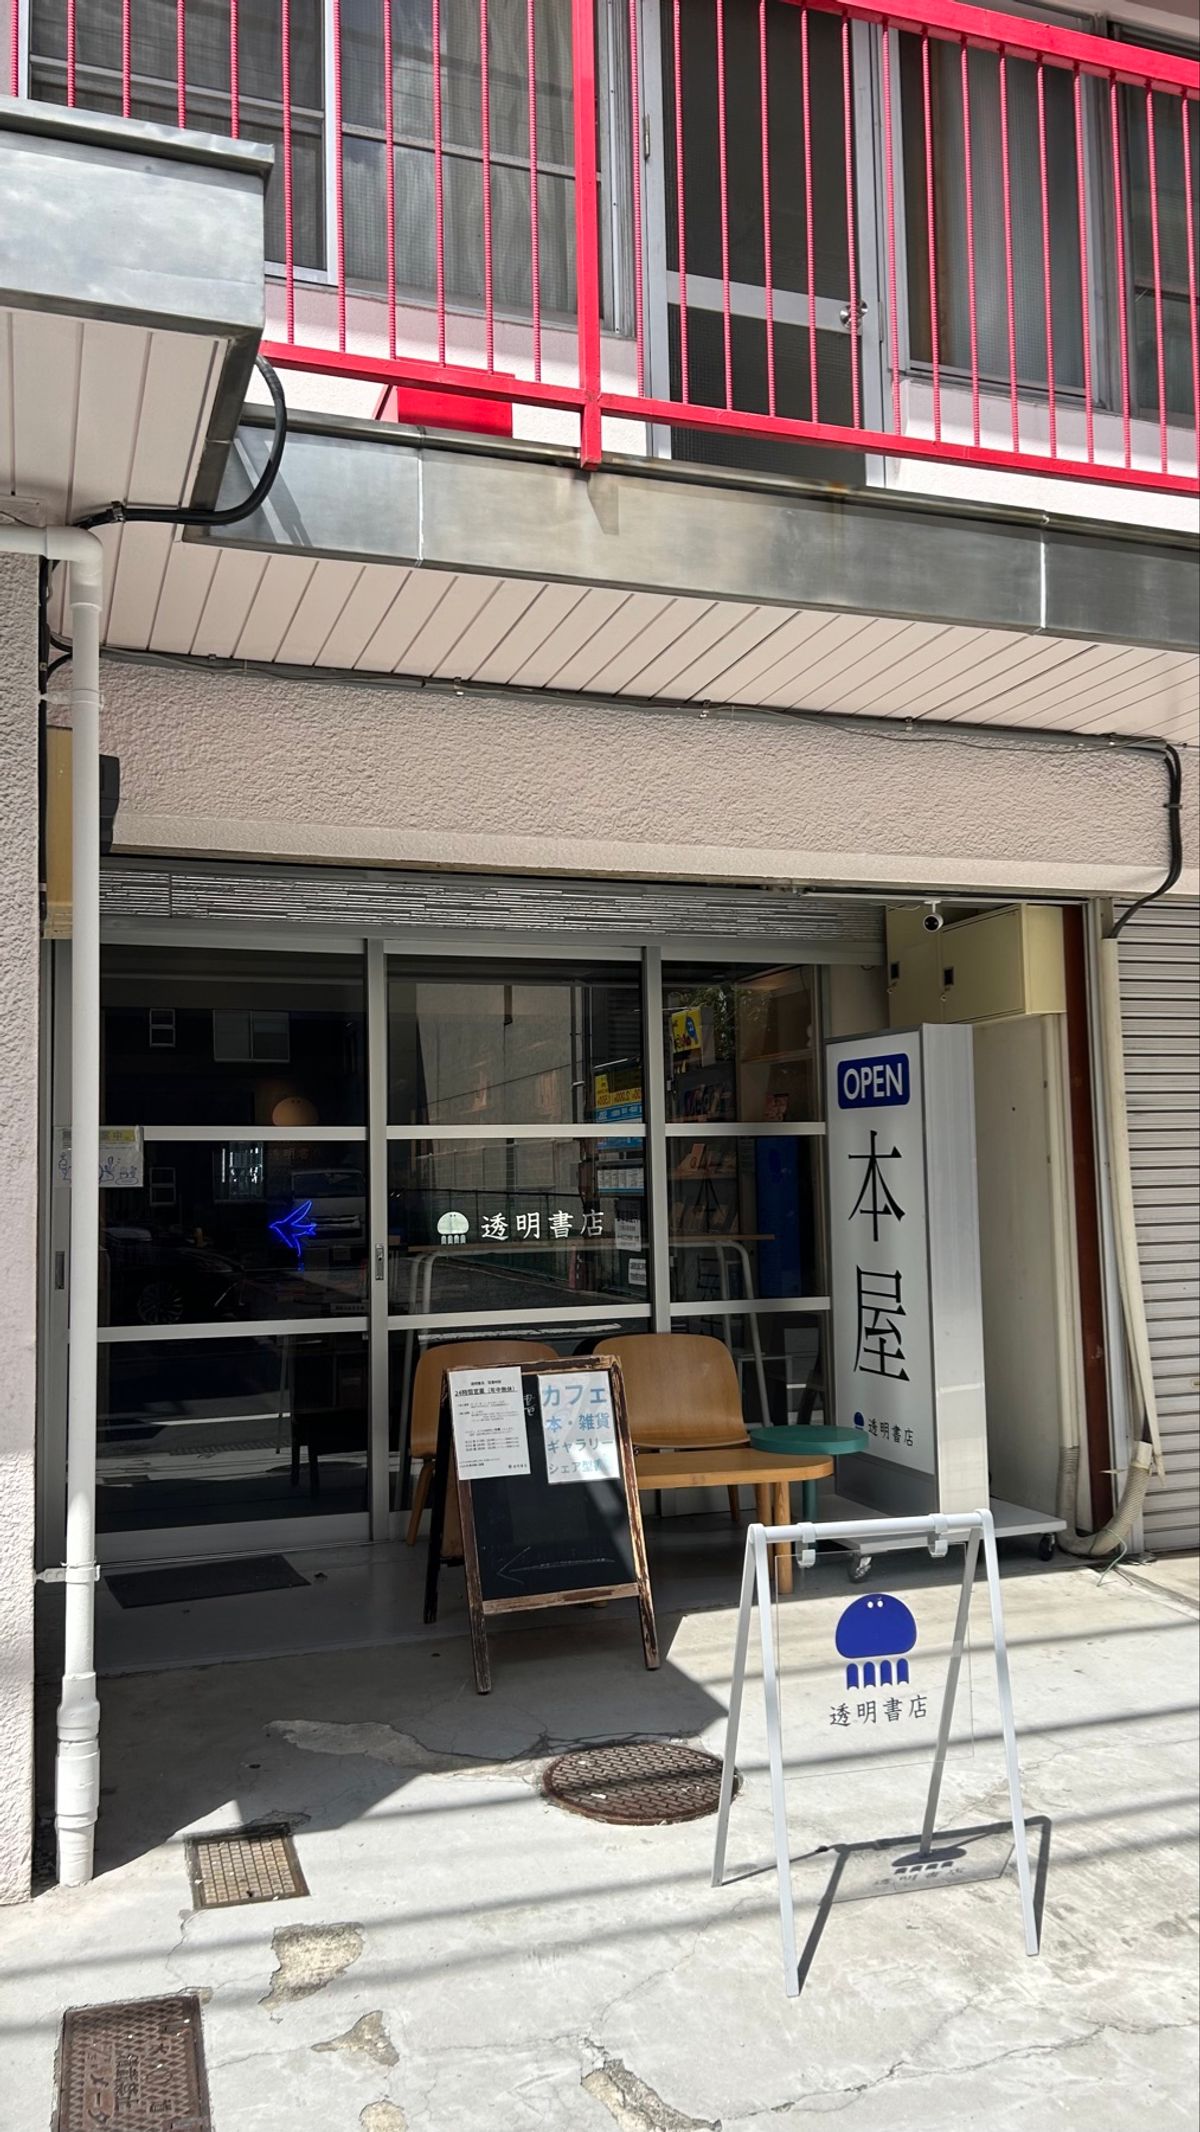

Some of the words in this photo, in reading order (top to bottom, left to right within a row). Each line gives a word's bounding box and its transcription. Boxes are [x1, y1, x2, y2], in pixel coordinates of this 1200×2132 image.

[843, 1062, 904, 1101] OPEN
[480, 1208, 605, 1241] 透明書店
[848, 1129, 911, 1382] 本屋
[543, 1384, 608, 1407] カフェ
[545, 1412, 610, 1434] 本・雑貨
[867, 1416, 915, 1447] 透明書店
[547, 1437, 614, 1454] ギャラリー
[828, 1693, 928, 1728] 透明書店
